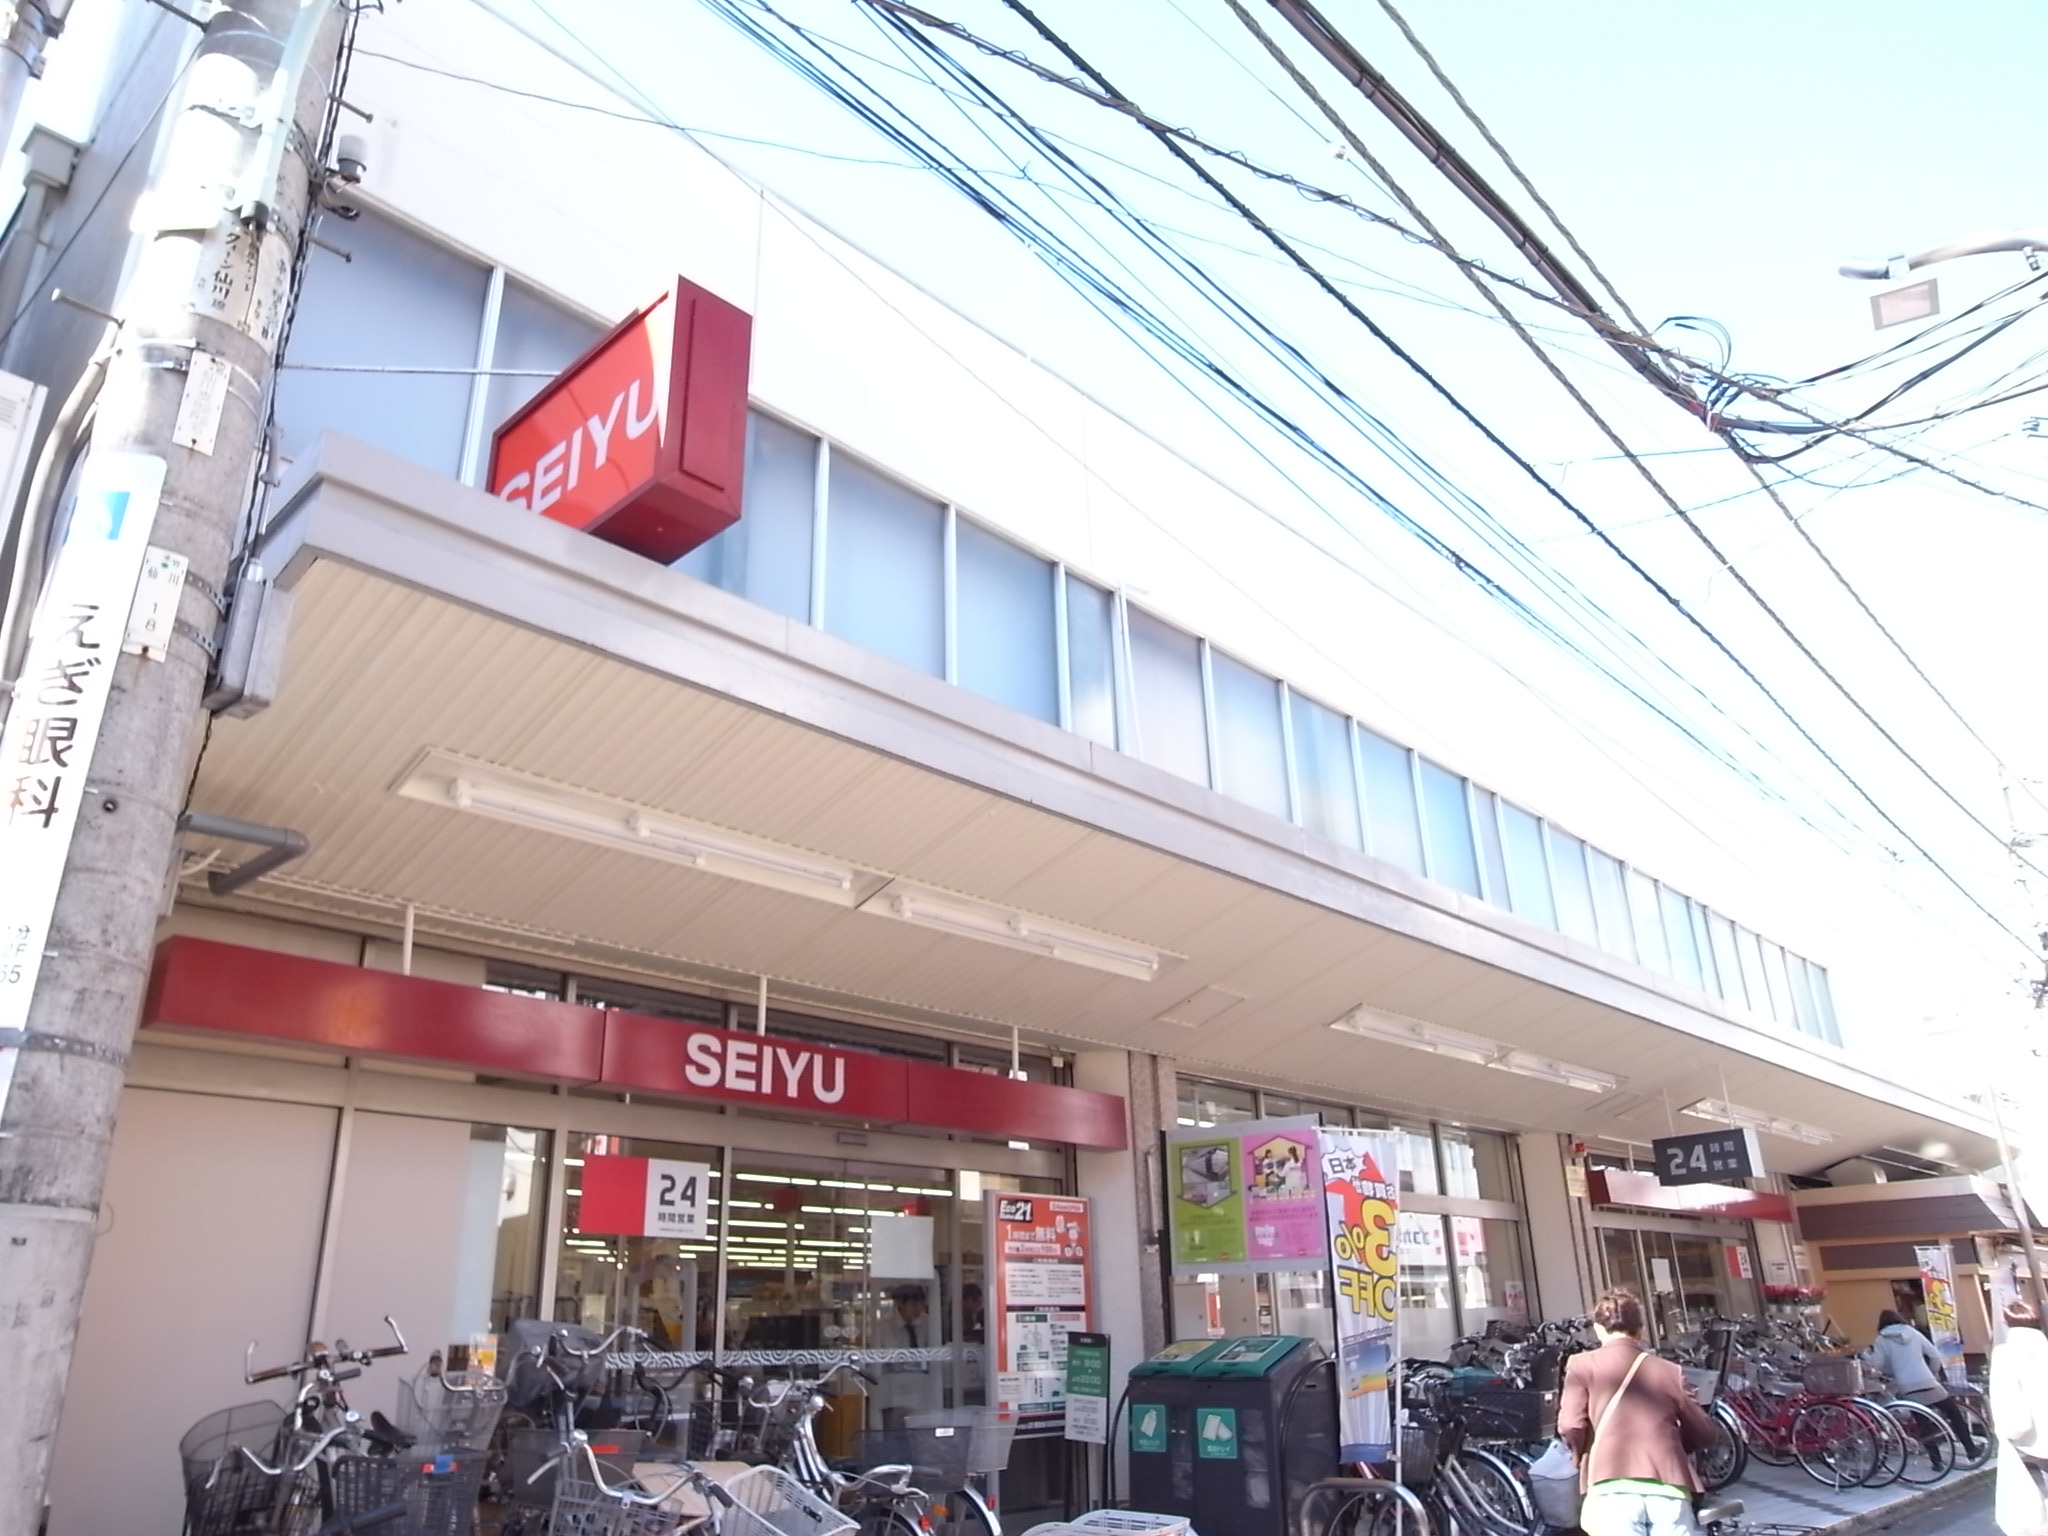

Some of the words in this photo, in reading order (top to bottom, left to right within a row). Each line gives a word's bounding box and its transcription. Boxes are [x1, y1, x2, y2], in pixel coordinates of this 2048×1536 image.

[499, 379, 660, 516] SEIYU
[8, 603, 102, 829] えぎ眼科
[684, 1032, 846, 1104] SEIYU
[659, 1173, 698, 1208] 24
[1667, 1144, 1707, 1176] 24
